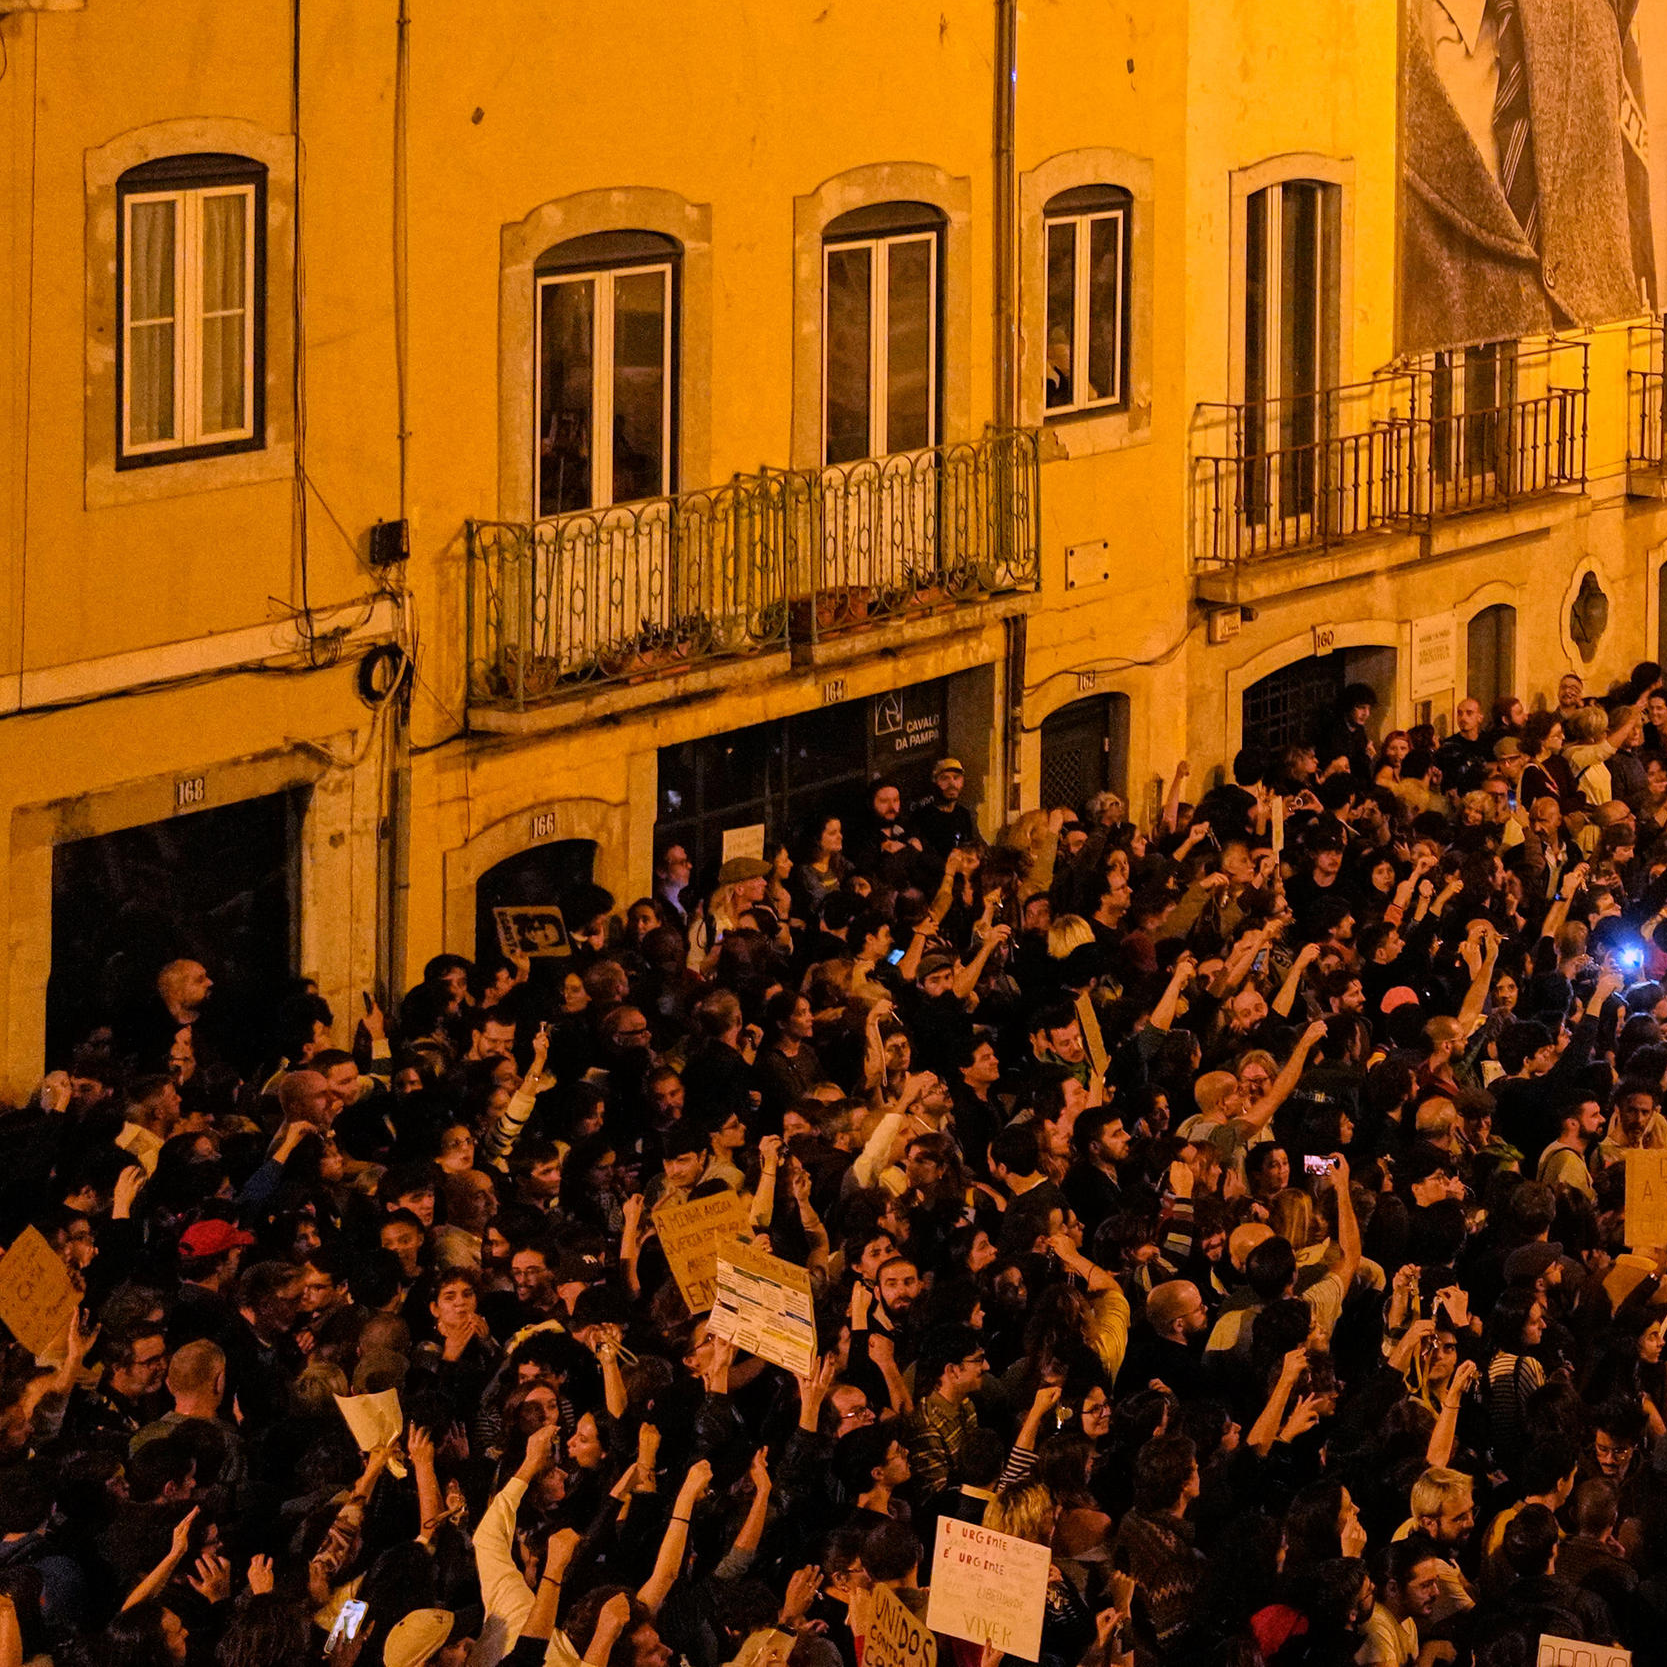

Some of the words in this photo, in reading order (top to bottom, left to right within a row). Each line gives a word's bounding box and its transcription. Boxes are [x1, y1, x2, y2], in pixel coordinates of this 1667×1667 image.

[825, 680, 844, 703] 164
[1080, 671, 1097, 691] 162
[906, 714, 940, 733] CAVALO
[895, 735, 910, 751] DA
[178, 777, 204, 806] 168
[533, 813, 555, 837] 166
[961, 1526, 1008, 1552] URGENTE
[959, 1551, 1005, 1576] URGENTE
